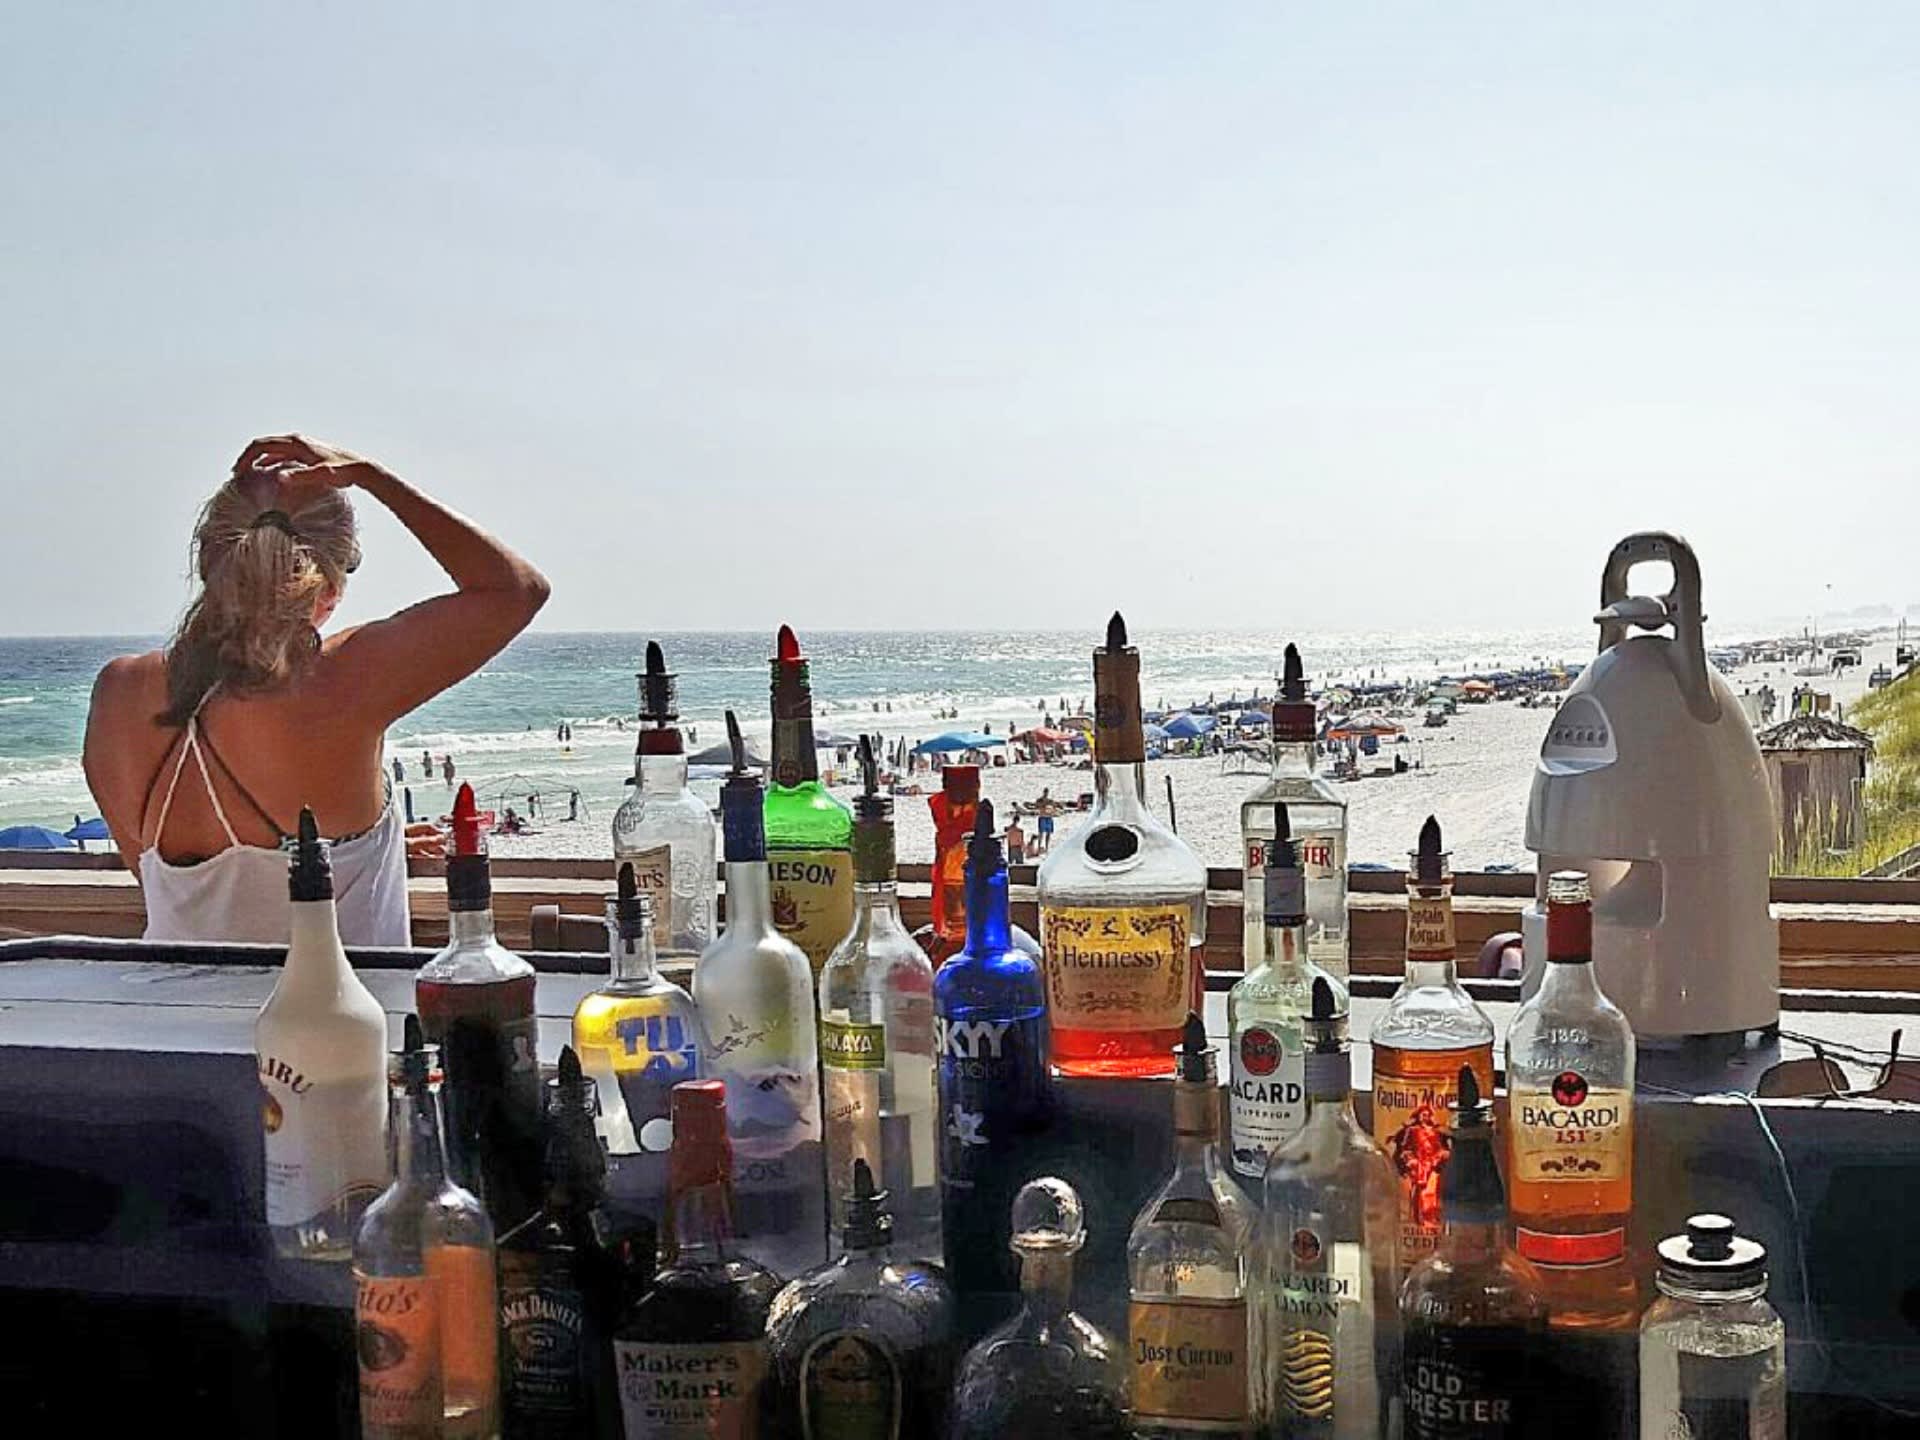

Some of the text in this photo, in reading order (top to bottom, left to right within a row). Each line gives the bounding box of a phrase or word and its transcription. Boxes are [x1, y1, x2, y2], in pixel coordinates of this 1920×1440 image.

[1061, 944, 1162, 972] Hennessy
[1232, 1079, 1302, 1104] ACARD
[1523, 1106, 1619, 1129] BACARDI
[623, 1351, 740, 1373] Maker's
[655, 1379, 736, 1400] Mark
[1418, 1366, 1462, 1396] OLD
